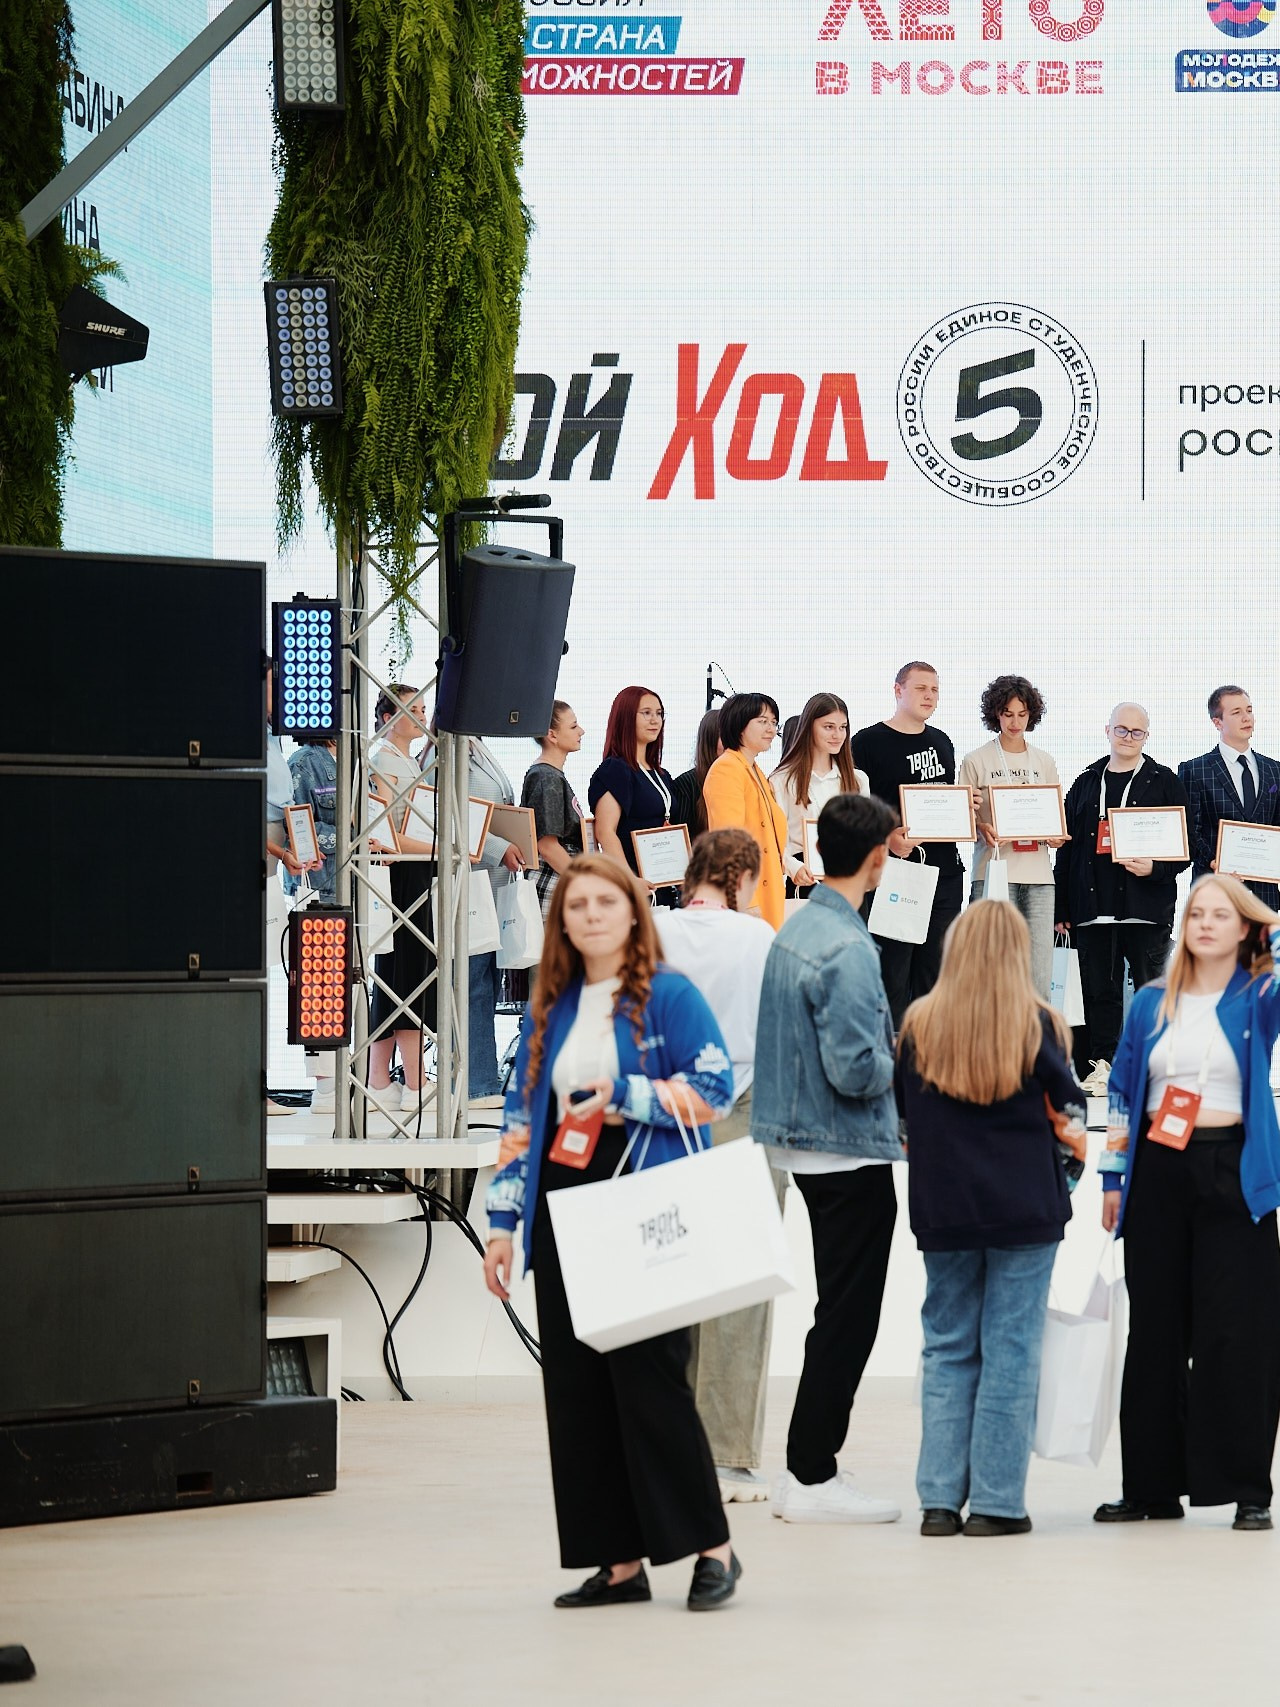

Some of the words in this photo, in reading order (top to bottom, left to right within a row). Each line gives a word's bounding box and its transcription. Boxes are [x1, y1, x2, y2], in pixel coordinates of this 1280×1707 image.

[531, 23, 666, 50] СТРАНА
[816, 61, 849, 95] В
[871, 60, 1105, 95] МОСКВЕ
[86, 321, 127, 337] SHURE
[936, 310, 1022, 343] ЕДИНОЕ
[904, 344, 935, 437] РОССИИ
[951, 348, 1043, 461] 5
[1029, 318, 1092, 470] СТУДЕНЧЕСКОЕ
[915, 442, 1056, 499] СООБЩЕСТВО
[900, 896, 919, 906] store
